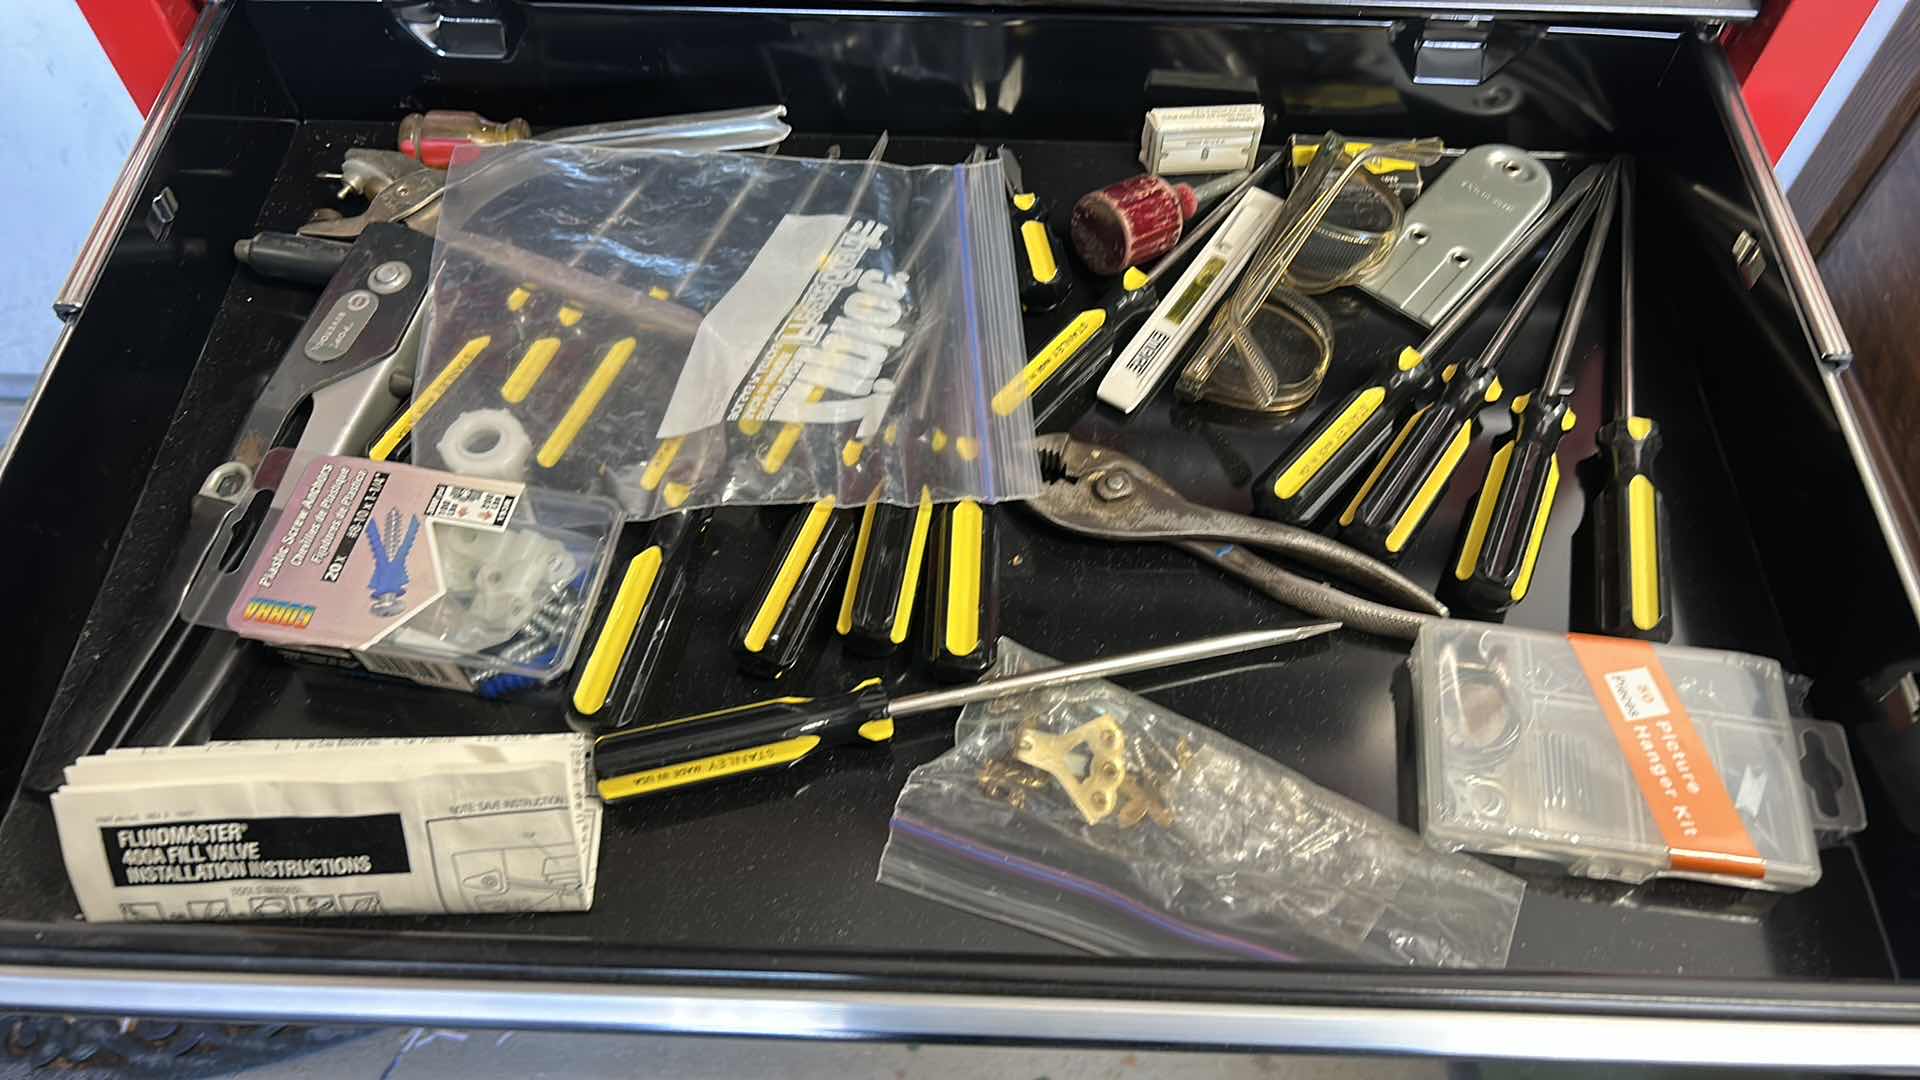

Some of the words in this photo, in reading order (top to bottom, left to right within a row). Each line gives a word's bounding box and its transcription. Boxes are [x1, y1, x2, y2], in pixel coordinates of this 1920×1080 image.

[258, 544, 290, 589] Plastic
[280, 507, 310, 547] Screw
[301, 463, 334, 511] Anchors
[1633, 724, 1679, 799] Hanger
[1673, 804, 1698, 838] Kit
[1656, 720, 1701, 794] Picture
[126, 860, 248, 885] INSTALLATION
[249, 855, 372, 879] INSTRUCTIONS
[167, 845, 206, 864] FILL
[206, 841, 261, 861] VALVE
